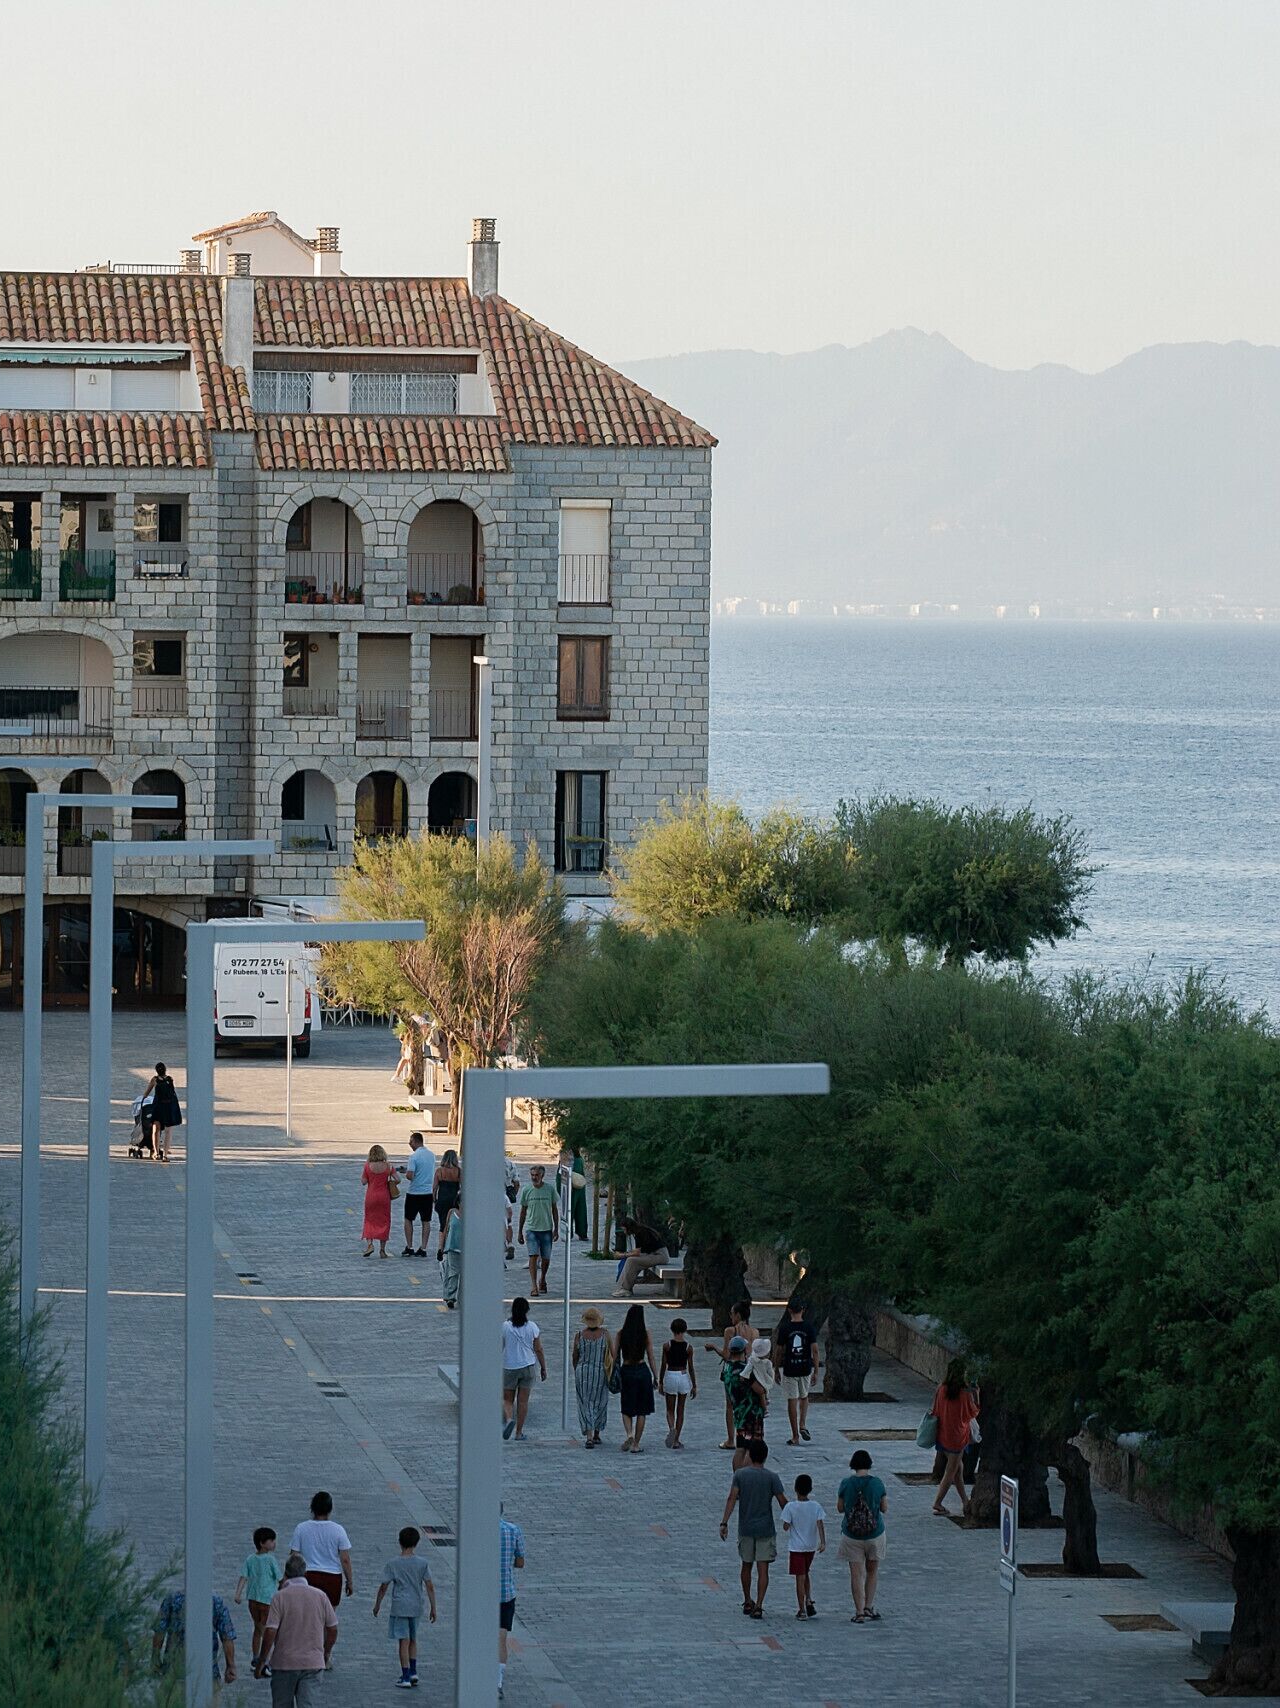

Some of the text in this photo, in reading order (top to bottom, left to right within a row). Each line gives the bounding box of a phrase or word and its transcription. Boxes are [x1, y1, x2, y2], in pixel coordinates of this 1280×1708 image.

[230, 958, 284, 966] 972 77 27 54
